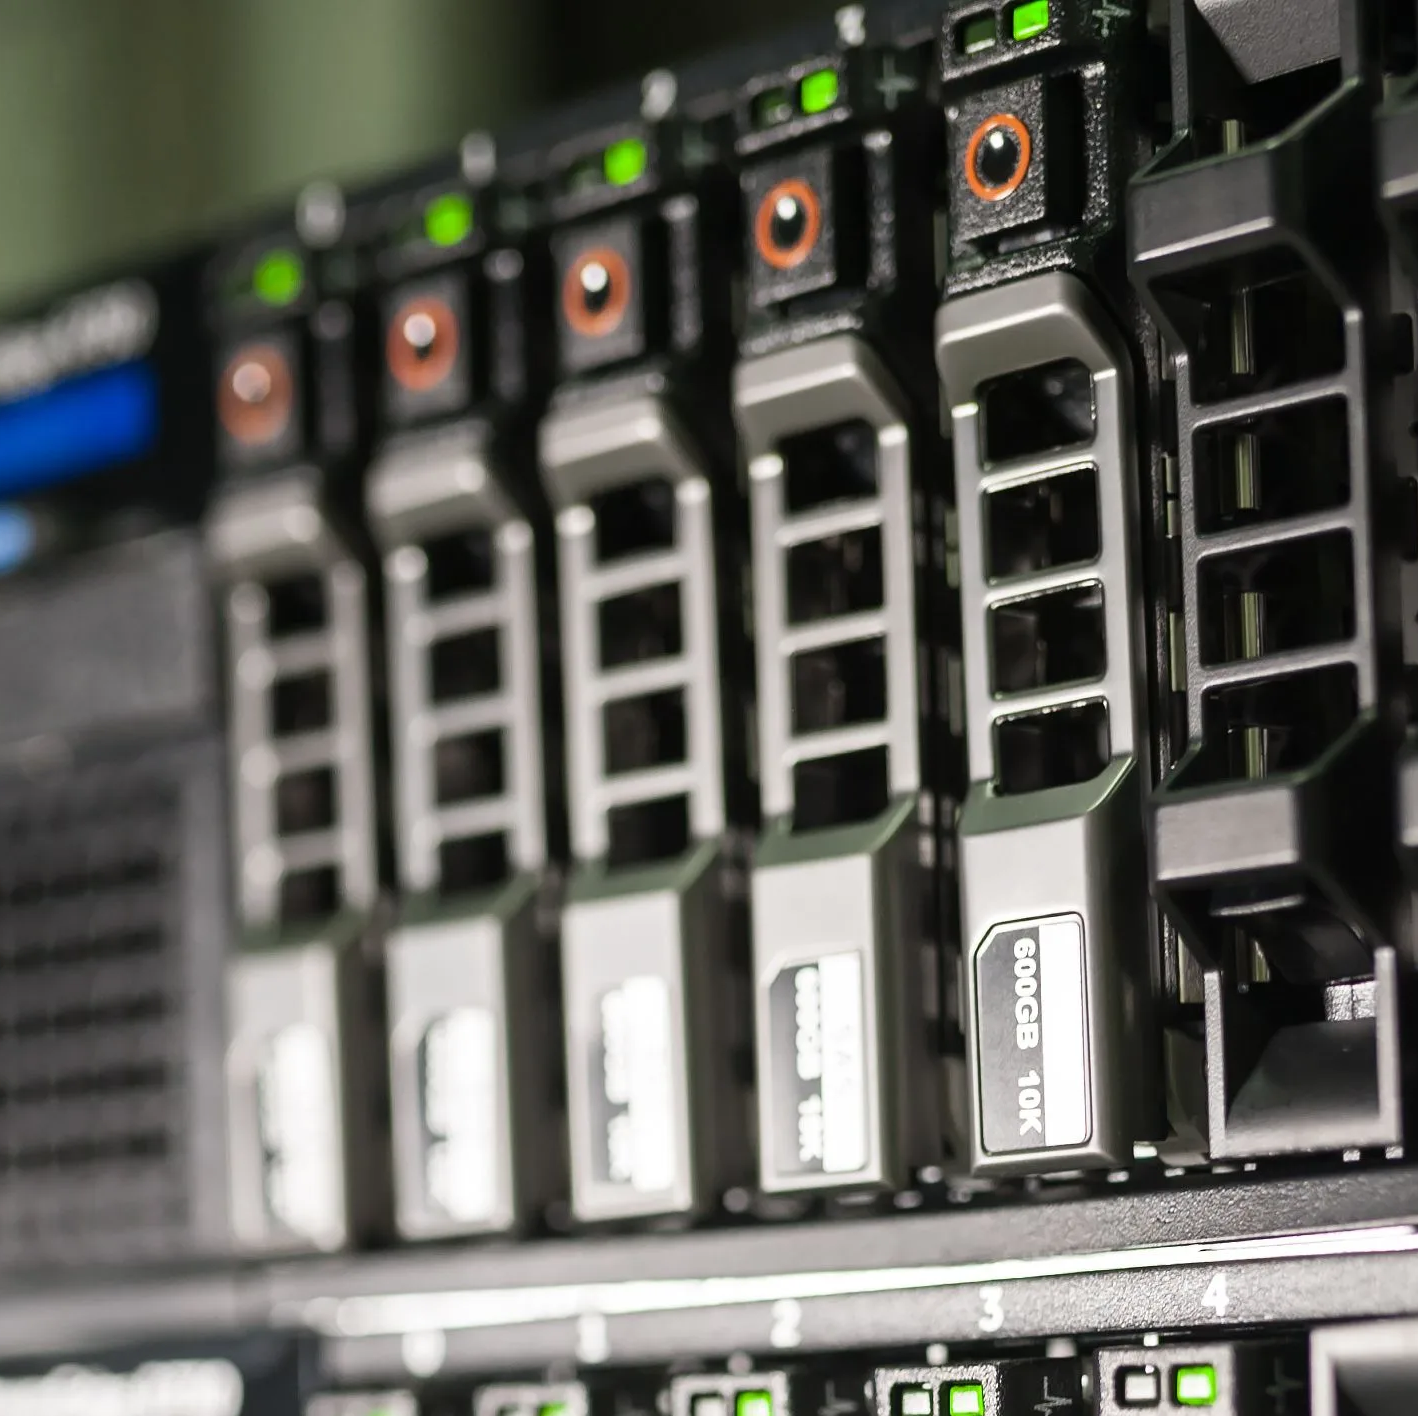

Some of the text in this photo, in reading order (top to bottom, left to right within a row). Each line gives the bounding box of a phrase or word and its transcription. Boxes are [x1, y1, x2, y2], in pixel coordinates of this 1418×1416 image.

[1013, 938, 1042, 1136] 600GB 10K
[978, 1286, 1004, 1332] 3
[1201, 1272, 1230, 1317] 4
[770, 1299, 802, 1348] 2
